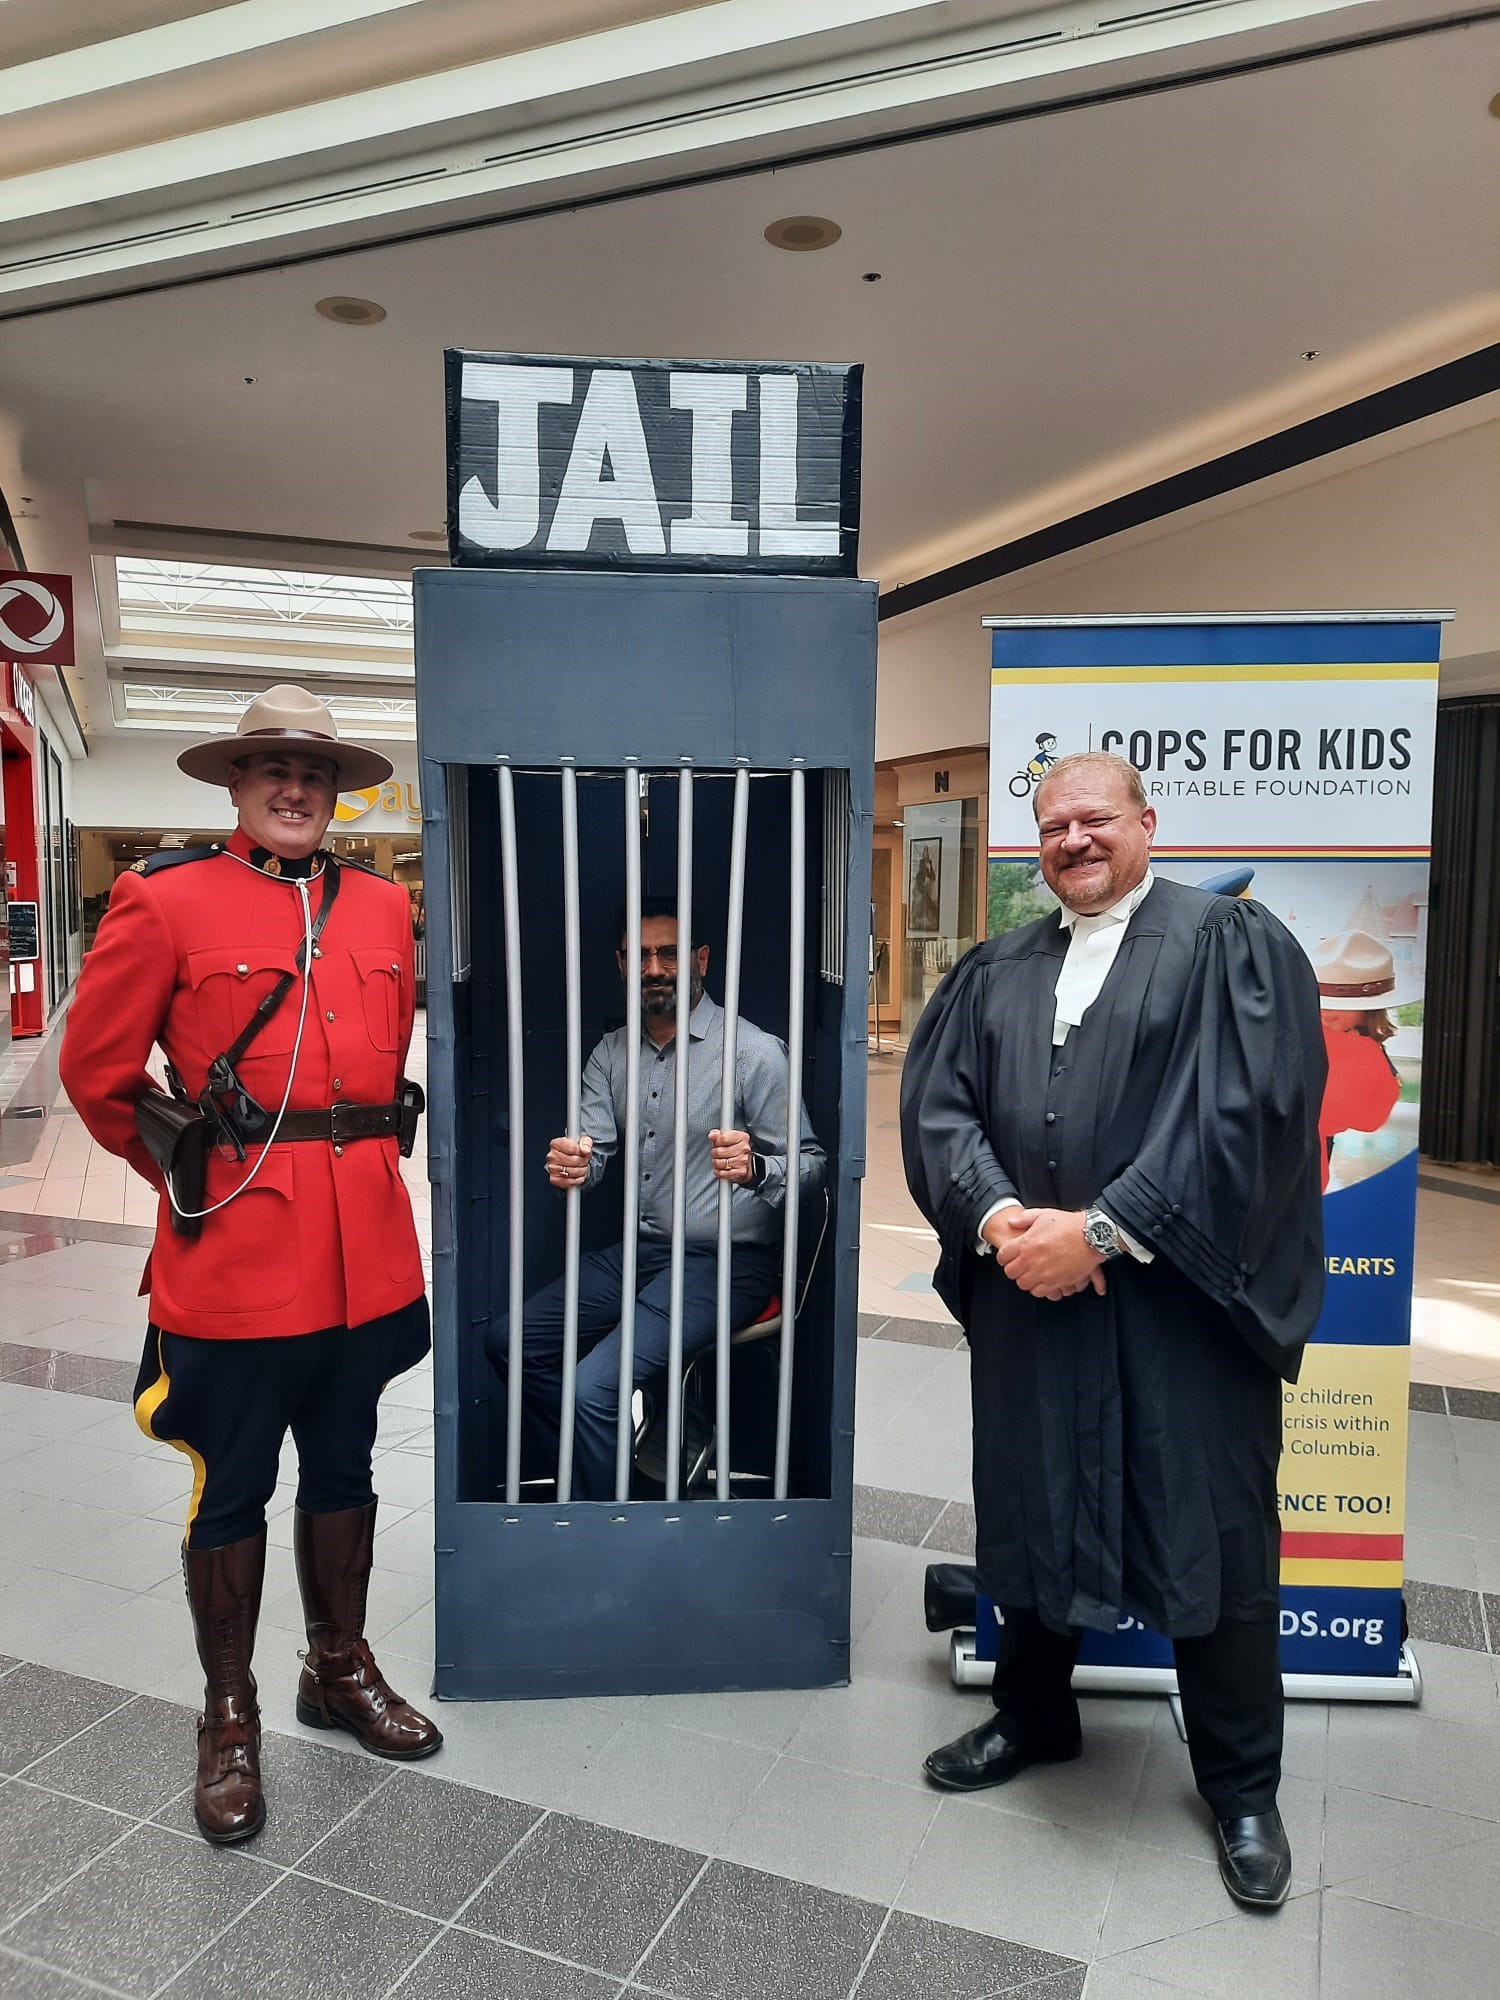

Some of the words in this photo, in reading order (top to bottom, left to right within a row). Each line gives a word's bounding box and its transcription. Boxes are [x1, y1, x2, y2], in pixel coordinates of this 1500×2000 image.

[459, 362, 840, 557] JAIL
[1223, 728, 1301, 771] FOR
[1319, 728, 1412, 770] KIDS
[1143, 780, 1246, 797] RITABLE
[1256, 779, 1411, 797] FOUNDATION
[1324, 1257, 1396, 1276] EARTS
[1300, 1388, 1373, 1405] children
[1284, 1414, 1328, 1429] crisis
[1333, 1416, 1389, 1431] within
[1291, 1440, 1381, 1457] Columbia.
[1334, 1495, 1391, 1514] TOO!
